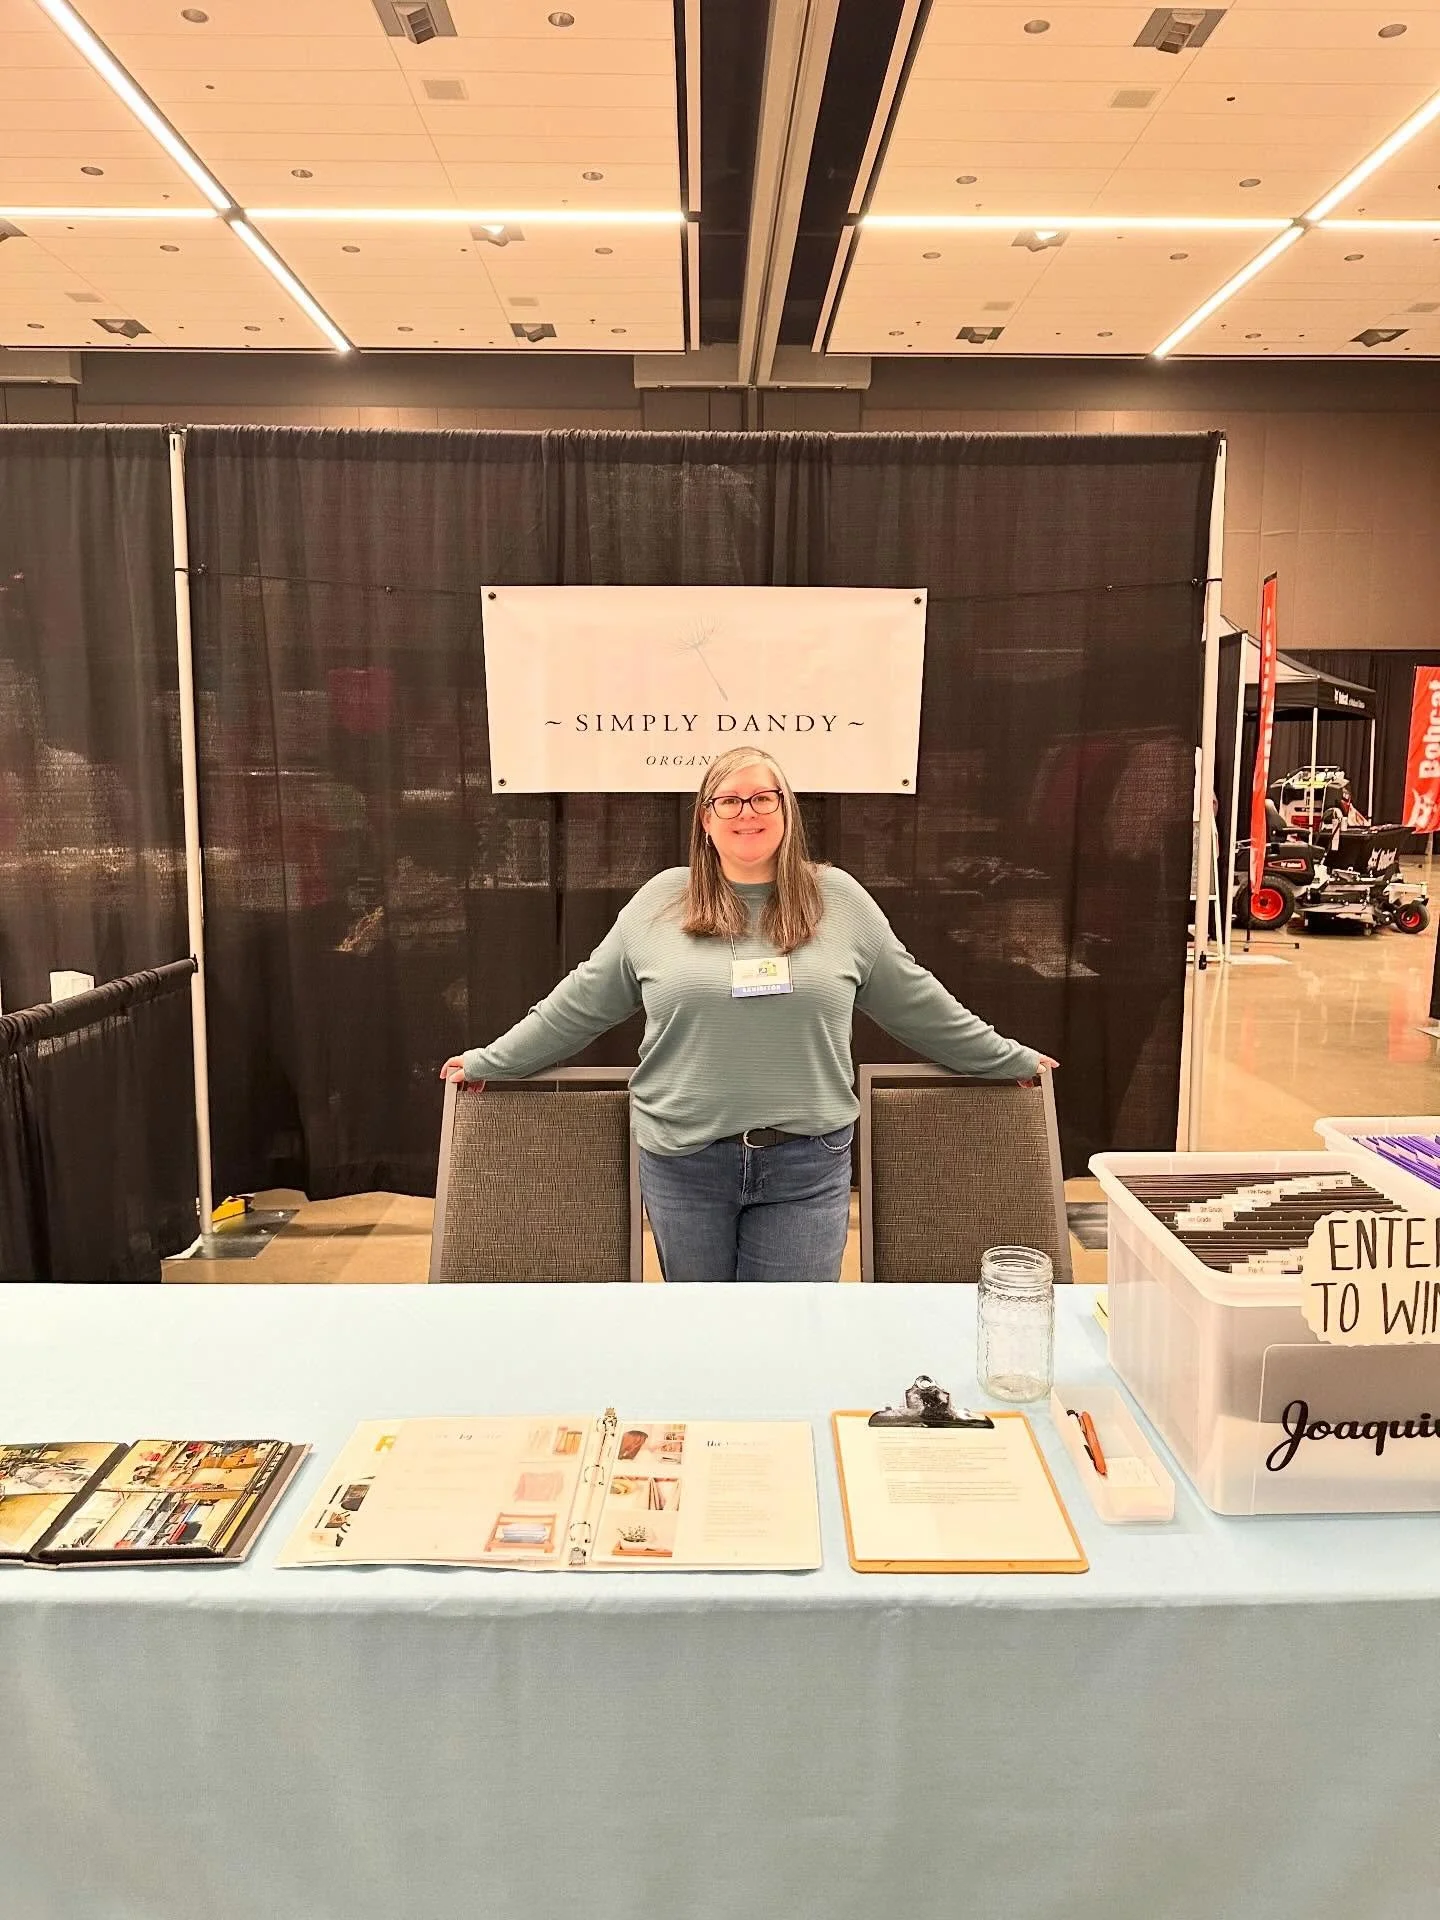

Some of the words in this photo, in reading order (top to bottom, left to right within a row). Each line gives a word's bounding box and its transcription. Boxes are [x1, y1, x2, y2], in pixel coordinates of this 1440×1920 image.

[575, 713, 699, 733] SIMPLY
[716, 713, 840, 733] DANDY
[645, 755, 719, 766] ORGAN
[1328, 1217, 1440, 1271] ENTE
[1310, 1282, 1360, 1333] TO
